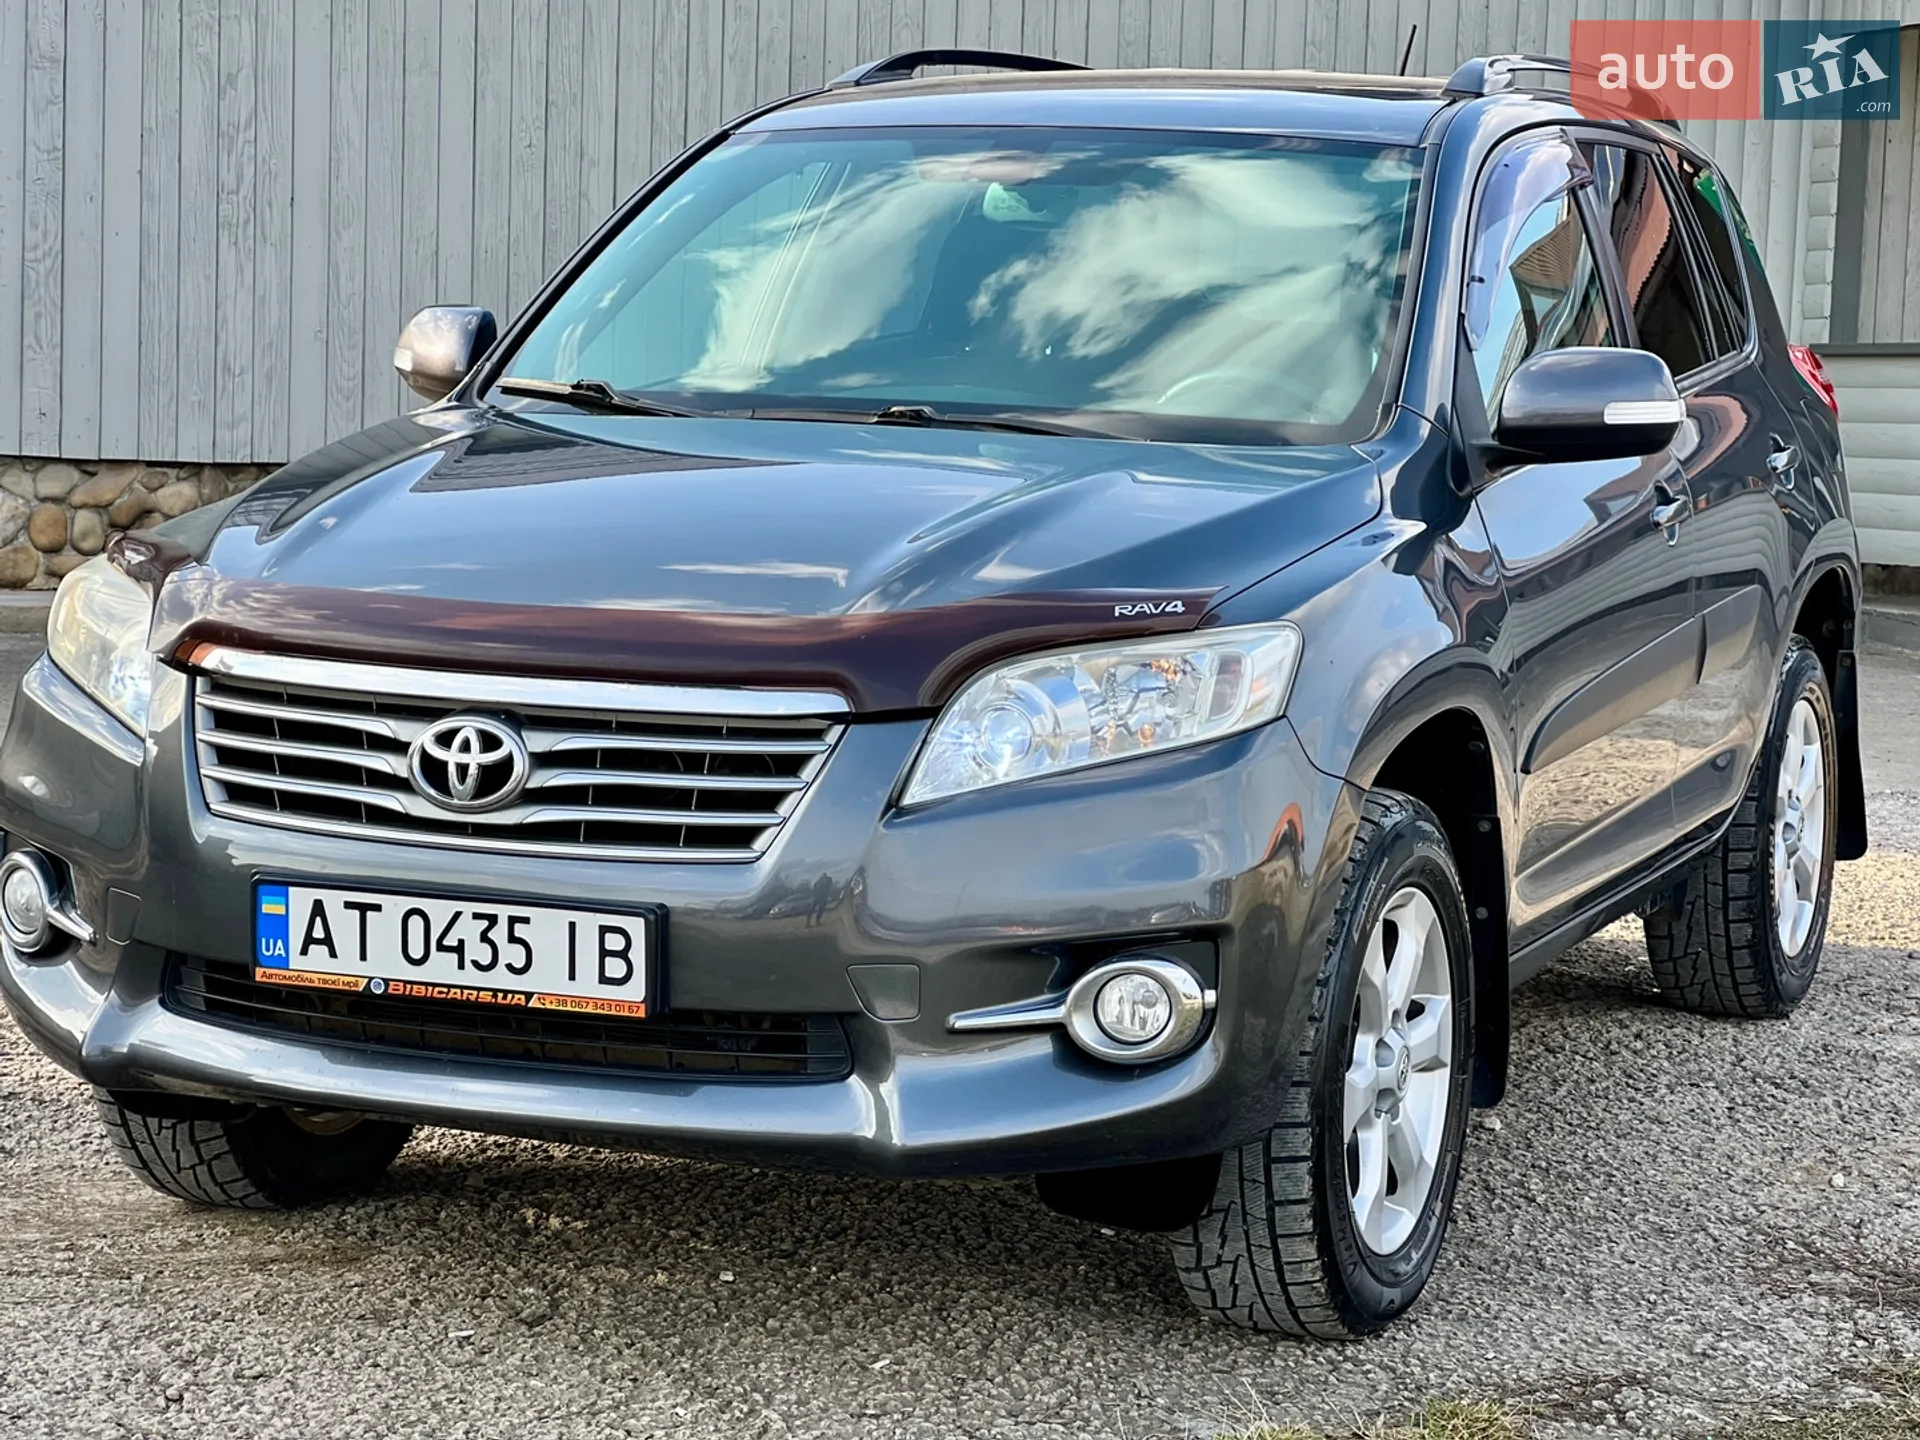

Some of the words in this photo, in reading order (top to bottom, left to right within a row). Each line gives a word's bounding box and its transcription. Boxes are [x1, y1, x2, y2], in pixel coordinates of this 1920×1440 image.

[1114, 600, 1185, 617] RAV4
[261, 937, 287, 958] UA
[299, 898, 383, 963] AT
[400, 906, 533, 976] 0435
[567, 921, 634, 987] IB
[260, 970, 316, 984] Автомобіль
[387, 980, 527, 1007] BIBICARS.UA
[548, 998, 568, 1008] +38
[570, 999, 590, 1010] 067
[592, 1002, 612, 1012] 343
[614, 1004, 625, 1014] 01
[628, 1005, 641, 1014] 67
